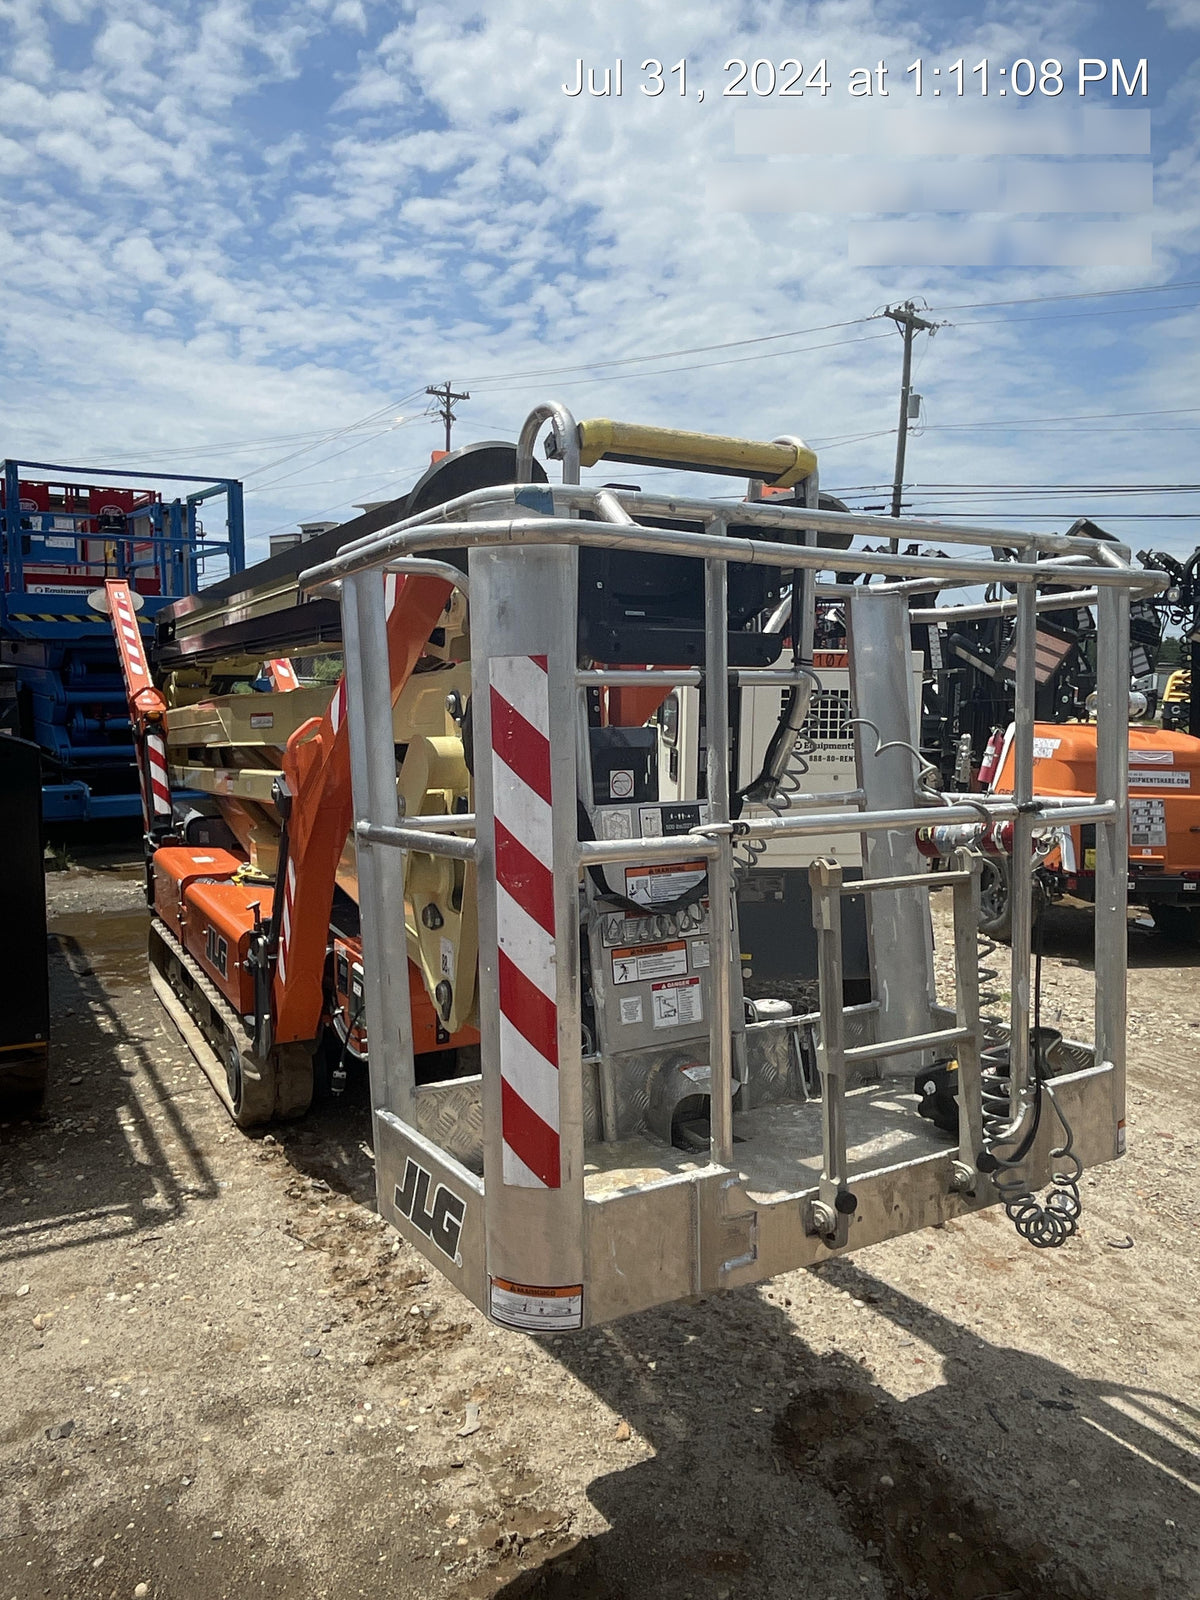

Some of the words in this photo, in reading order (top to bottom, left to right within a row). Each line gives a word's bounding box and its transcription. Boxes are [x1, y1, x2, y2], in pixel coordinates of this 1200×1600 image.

[815, 654, 845, 667] 107
[205, 923, 228, 981] JLG
[393, 1155, 467, 1264] JLG
